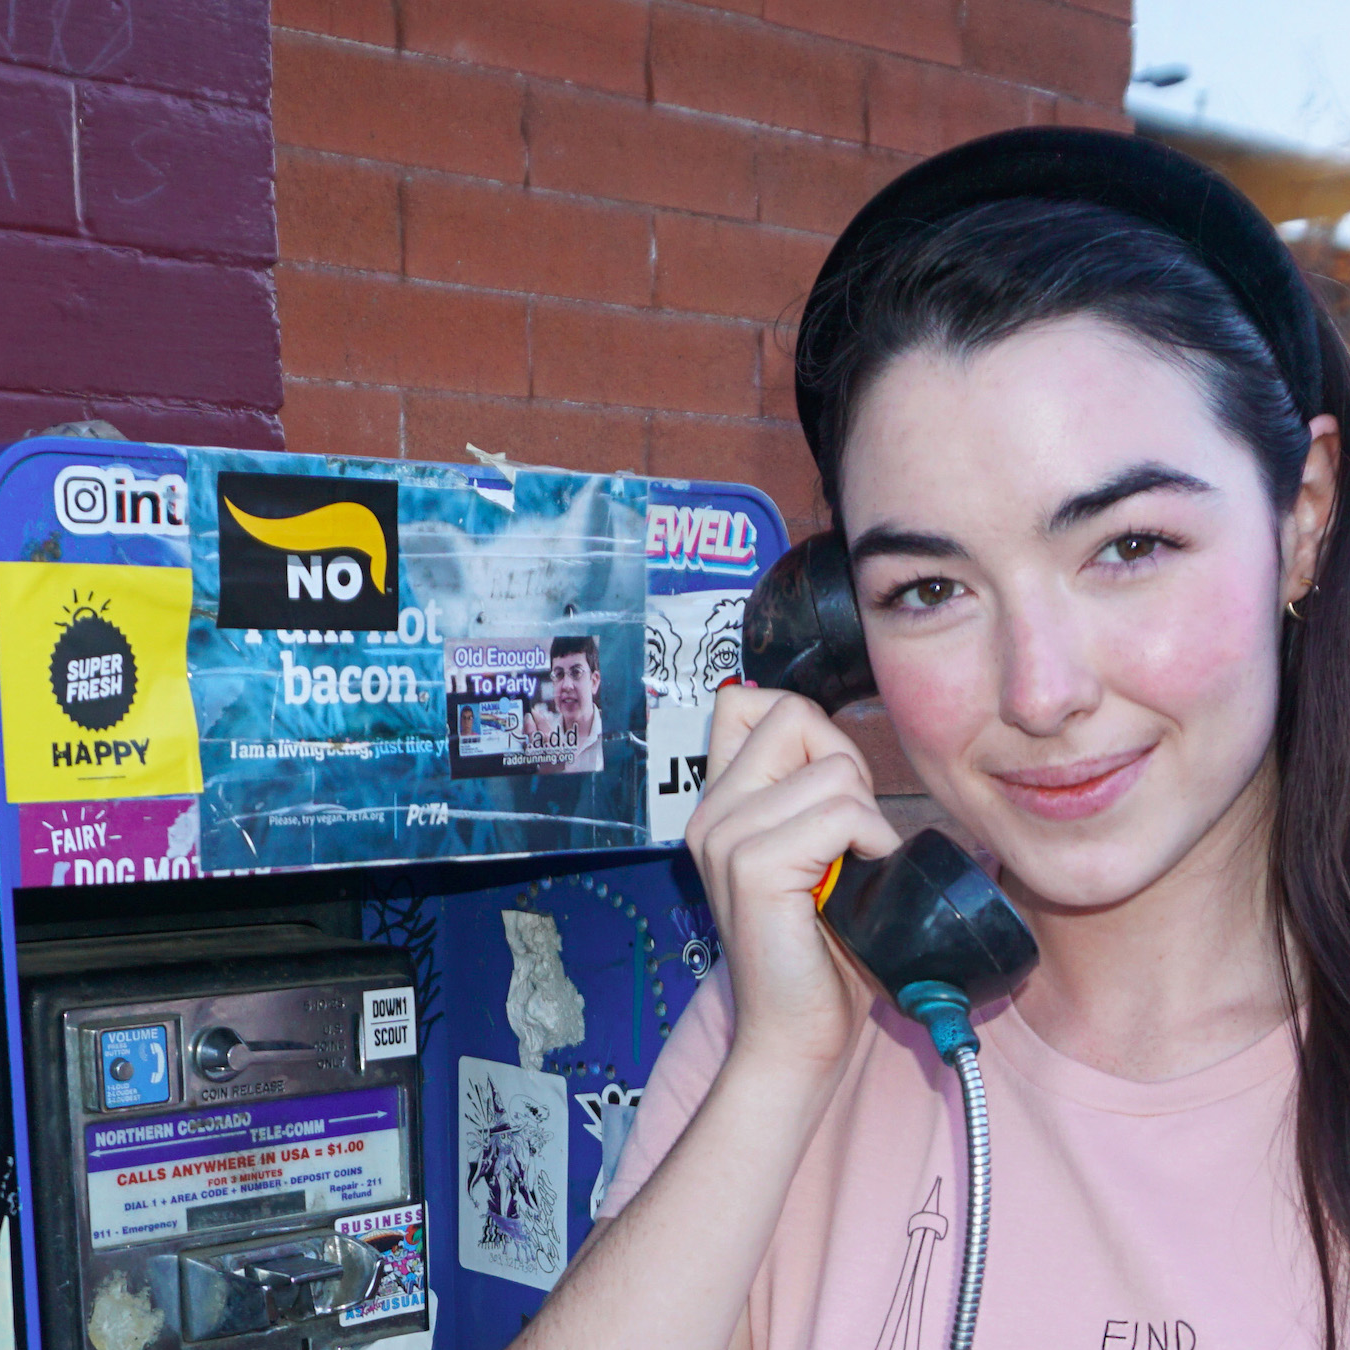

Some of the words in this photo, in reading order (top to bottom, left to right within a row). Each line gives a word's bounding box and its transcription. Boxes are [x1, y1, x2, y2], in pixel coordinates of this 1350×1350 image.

[286, 554, 364, 601] NO
[66, 653, 124, 682] SUPER
[454, 647, 483, 667] Old
[486, 646, 546, 669] Enough
[66, 674, 123, 704] FRESH
[471, 674, 493, 694] To
[495, 674, 537, 697] Party
[51, 736, 151, 767] HAPPY
[230, 740, 237, 759] I
[239, 744, 265, 759] am
[266, 744, 276, 759] a
[278, 738, 326, 762] living
[302, 814, 316, 826] try
[51, 822, 107, 855] FAIRY
[108, 1027, 159, 1044] VOLUME
[374, 1025, 409, 1047] SCOUT
[201, 1088, 229, 1101] COIN
[233, 1079, 286, 1097] RELEASE
[95, 1122, 174, 1148] NORTHERN
[177, 1111, 252, 1135] COLORADO
[250, 1119, 326, 1143] TELE-COMM
[116, 1167, 167, 1187] CALLS
[171, 1154, 257, 1179] ANYWHERE
[261, 1152, 277, 1166] IN
[281, 1147, 310, 1163] USA
[327, 1139, 365, 1158] $1.00
[124, 1200, 149, 1212] DIAL
[170, 1192, 198, 1205] AREA
[200, 1187, 229, 1200] CODE
[240, 1178, 282, 1193] NUMBER
[290, 1172, 331, 1185] DEPOSIT
[334, 1166, 363, 1178] COINS
[208, 1176, 228, 1187] FOR
[239, 1168, 284, 1183] MINUTES
[329, 1182, 357, 1194] Repair
[366, 1177, 382, 1189] 211
[341, 1189, 372, 1201] Refund
[93, 1228, 112, 1240] 911
[121, 1219, 179, 1236] Emergency
[340, 1208, 423, 1235] BUSINESS
